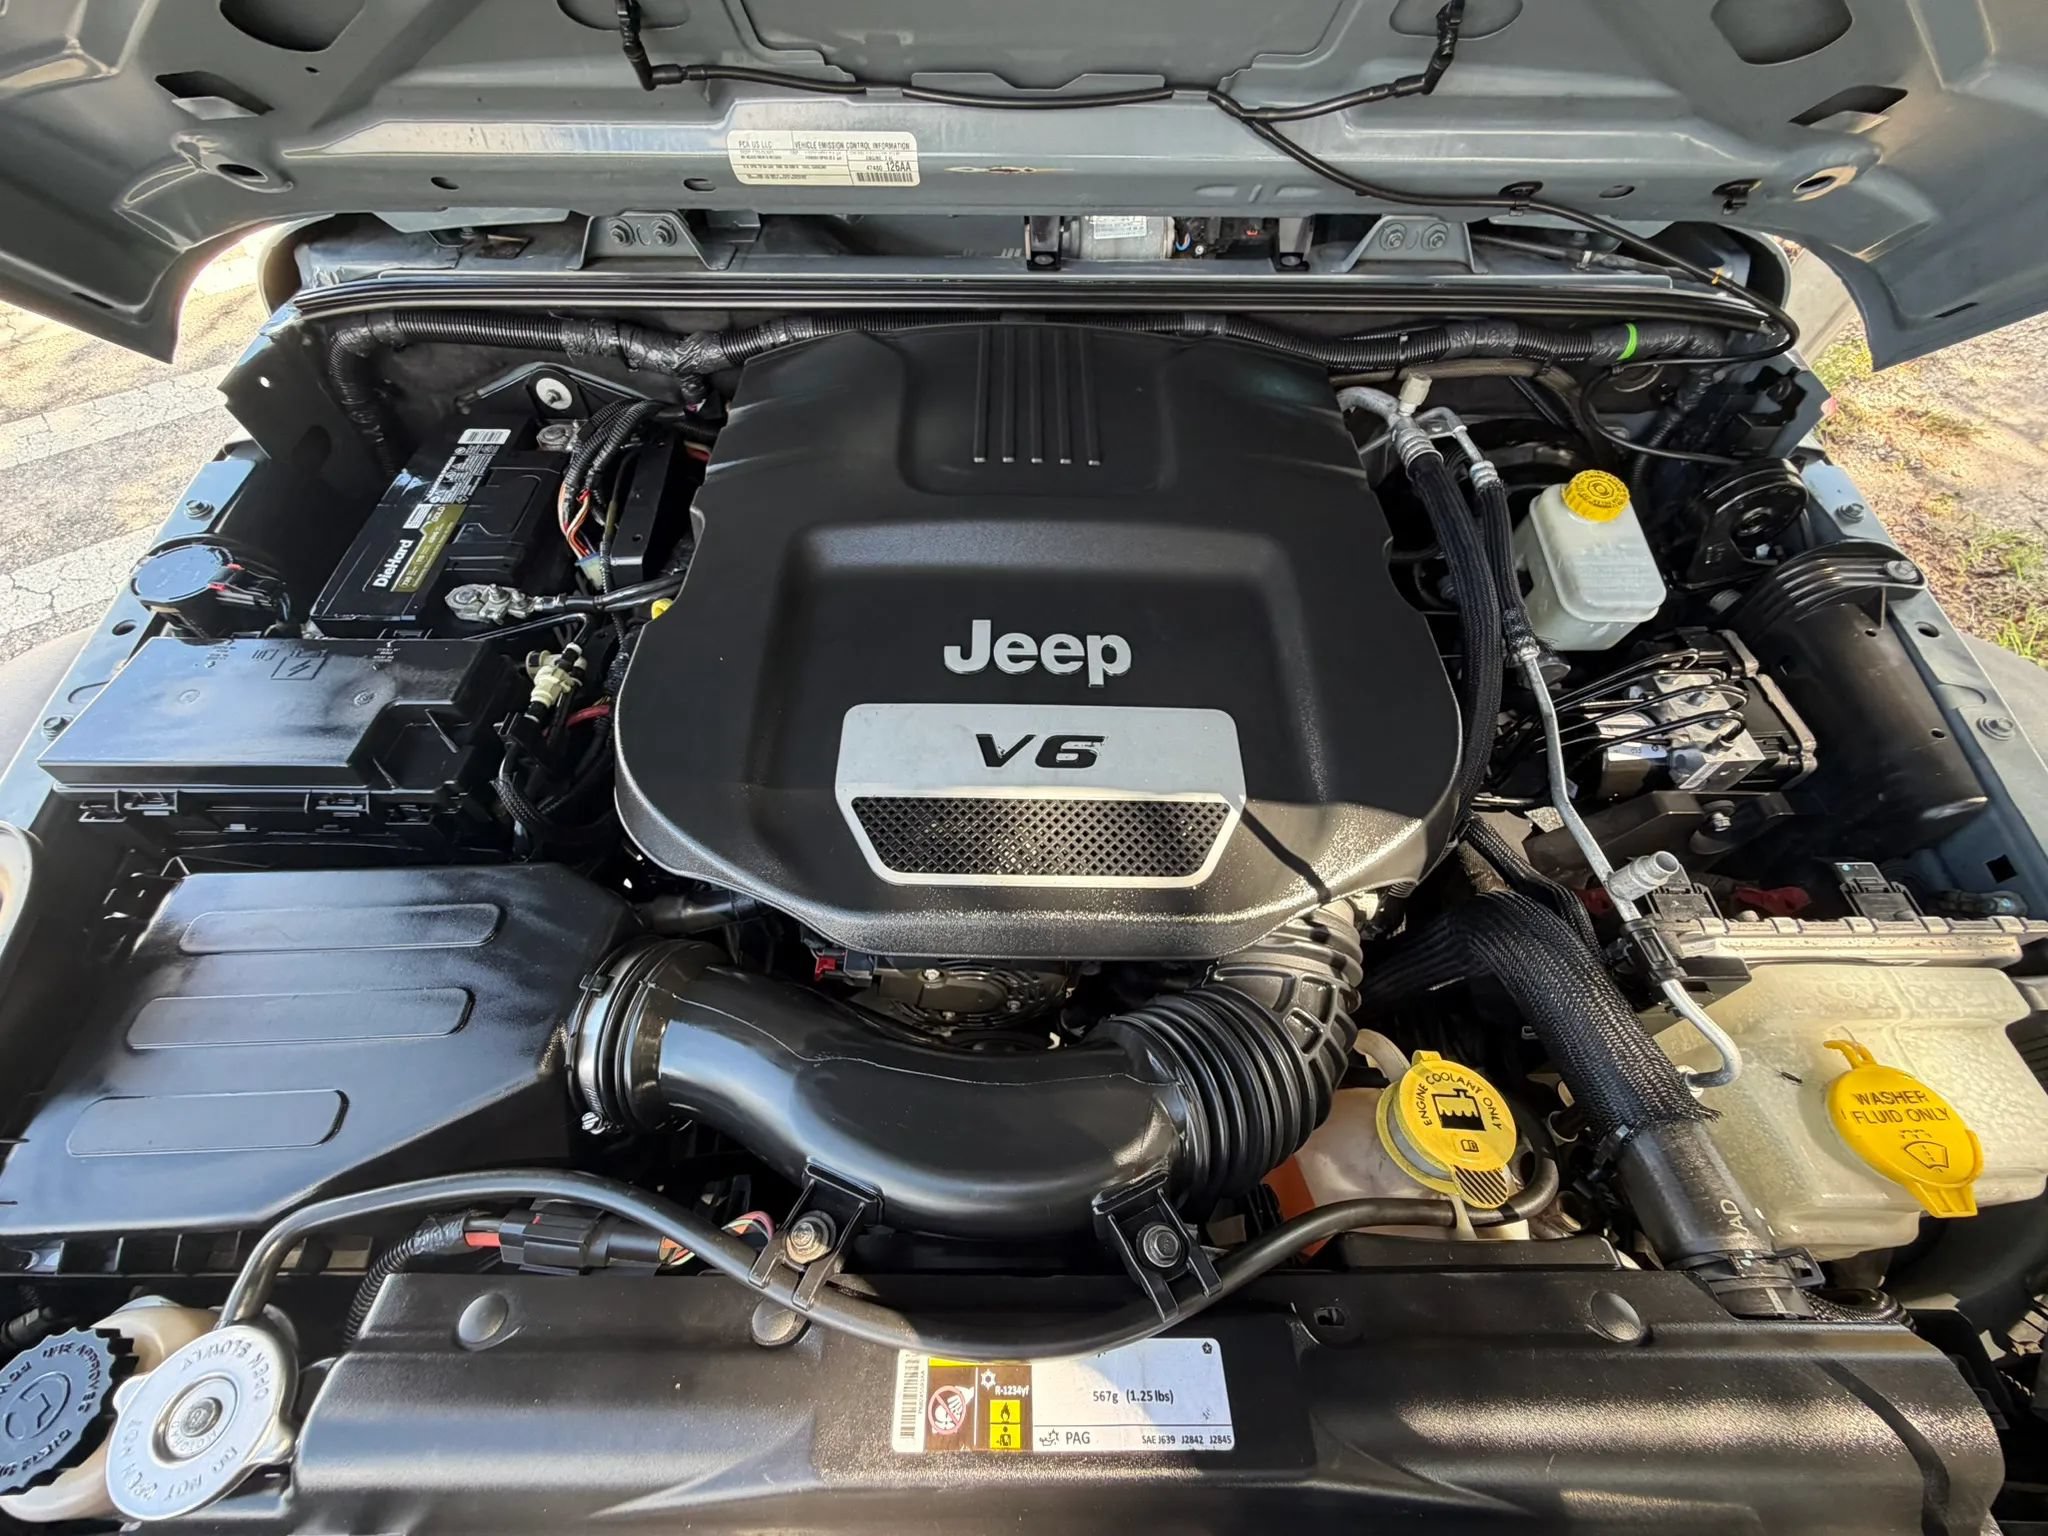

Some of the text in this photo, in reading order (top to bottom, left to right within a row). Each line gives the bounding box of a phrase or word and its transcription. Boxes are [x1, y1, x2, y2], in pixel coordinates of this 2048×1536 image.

[752, 140, 760, 149] US
[761, 140, 773, 149] LLC
[794, 141, 910, 151] VEHICLE EMISSION CONTROL INFORMATION
[886, 160, 912, 172] 126AA
[372, 539, 414, 587] DieHard
[943, 619, 1132, 687] Jeep
[976, 733, 1108, 768] V6
[1415, 1071, 1503, 1131] ENGINE COOLANT ONLY
[1853, 1090, 1929, 1106] WASHER
[1852, 1107, 1951, 1125] FLUID ONLY
[994, 1384, 1030, 1398] R-1234yf
[1093, 1388, 1174, 1405] 567g (1.25 lbs)
[1065, 1431, 1091, 1445] PAG
[1142, 1435, 1232, 1444] SAE J639 J2842 J2845
